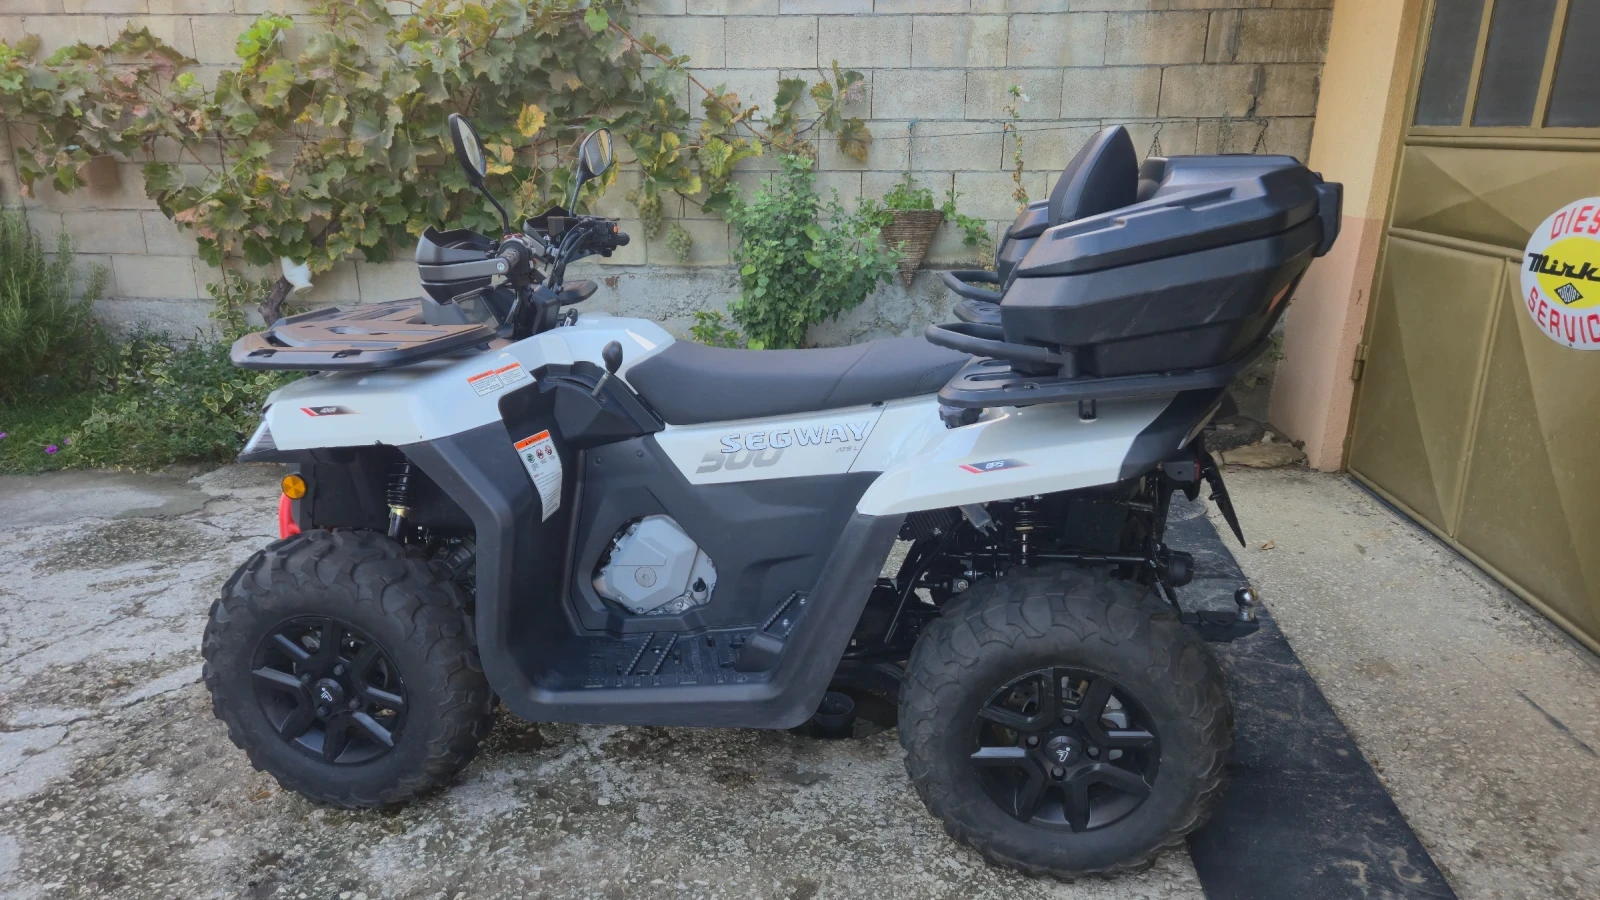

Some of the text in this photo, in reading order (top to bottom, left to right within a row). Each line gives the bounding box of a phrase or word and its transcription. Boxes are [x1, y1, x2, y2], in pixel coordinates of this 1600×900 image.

[1528, 286, 1600, 344] SERVIC
[719, 420, 869, 454] SEGWAY
[695, 447, 784, 474] 500
